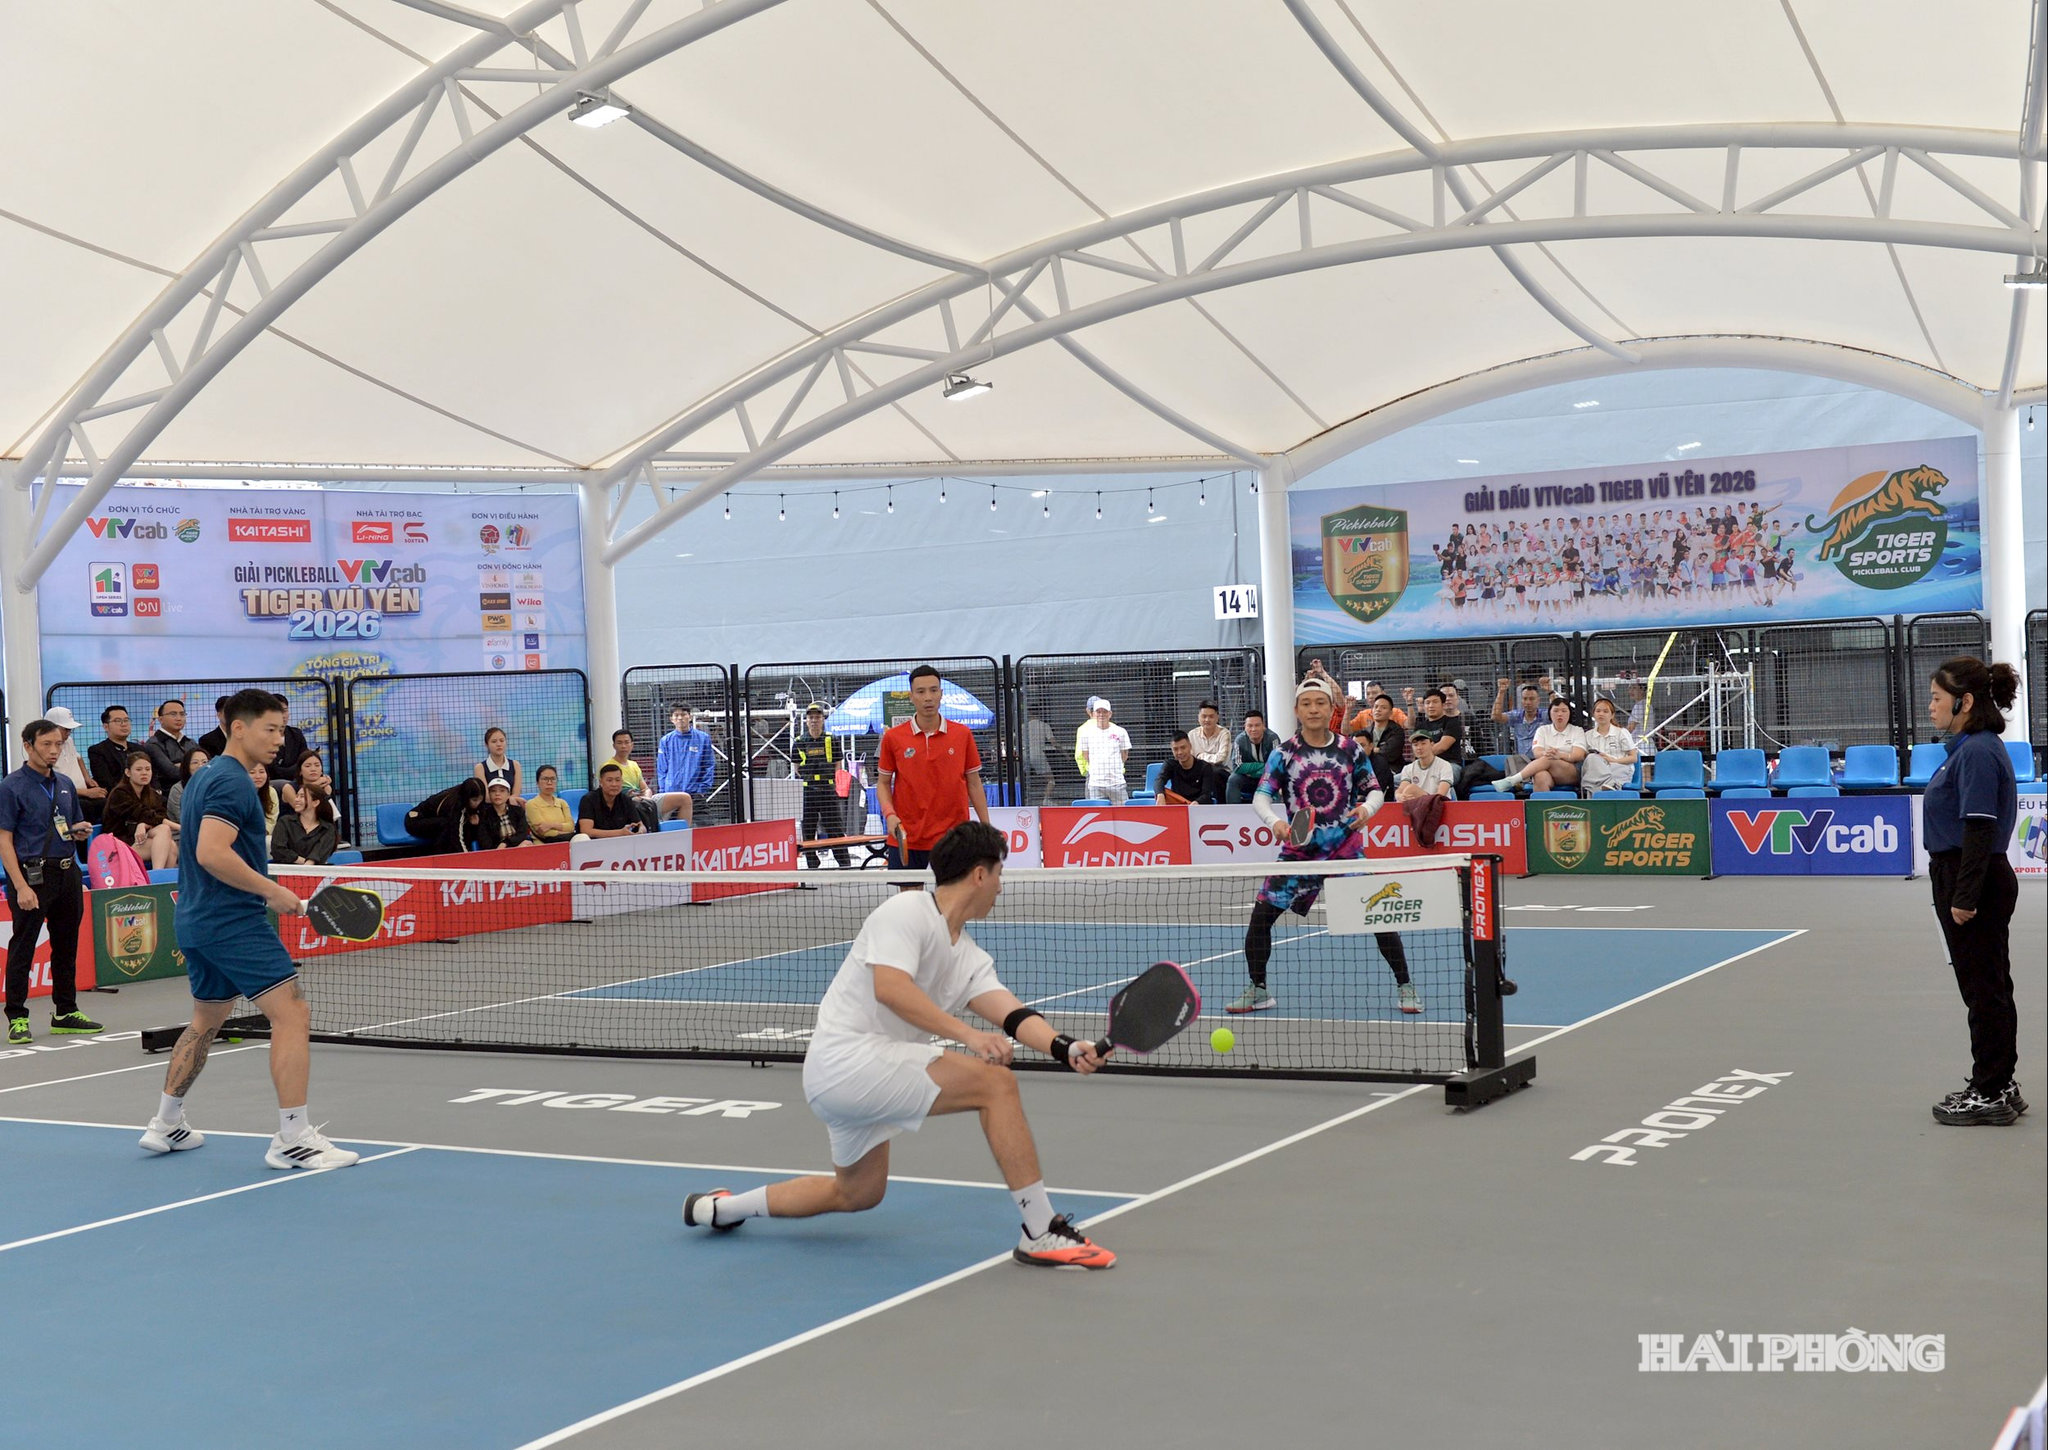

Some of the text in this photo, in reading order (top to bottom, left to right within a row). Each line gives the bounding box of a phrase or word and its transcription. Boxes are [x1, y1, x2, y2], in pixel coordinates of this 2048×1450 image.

[1464, 469, 1756, 513] GIẢI ĐẤU VTVcab TIGER VŨ YÊN 2026
[108, 504, 181, 514] ĐƠN VỊ TỔ CHỨC
[229, 506, 306, 516] NHÀ TÀI TRỢ VÀNG
[356, 509, 422, 519] NHÀ TÀI TRỢ BẠC
[85, 517, 168, 540] VTVcab
[235, 525, 304, 537] KAITASHI
[1329, 516, 1399, 533] Pickleball
[1337, 536, 1393, 553] VTVcab
[1876, 531, 1937, 549] TIGER
[1849, 547, 1933, 567] SPORTS
[234, 559, 427, 583] GIẢI PICKLEBALL VTVcab
[1852, 565, 1922, 576] PICKLEBALL CLUB
[242, 583, 421, 616] TIGER VŨ YÊN
[516, 598, 542, 606] Wika
[1219, 590, 1241, 614] 14
[1246, 589, 1256, 613] 14
[289, 609, 381, 639] 2026
[1547, 811, 1585, 820] Pickleball
[1359, 823, 1511, 848] KAIASHI
[1726, 809, 1898, 854] VTVcab
[1632, 833, 1695, 849] TIGER
[692, 840, 789, 872] KAITASHI
[1603, 850, 1692, 868] SPORTS
[2014, 866, 2042, 874] SPORT
[110, 901, 152, 914] Pickleball
[1382, 899, 1423, 912] TIGER
[1474, 861, 1486, 938] PRONEX
[1364, 911, 1422, 925] SPORTS
[447, 1087, 783, 1119] TIGER
[1569, 1068, 1795, 1167] PRONEX
